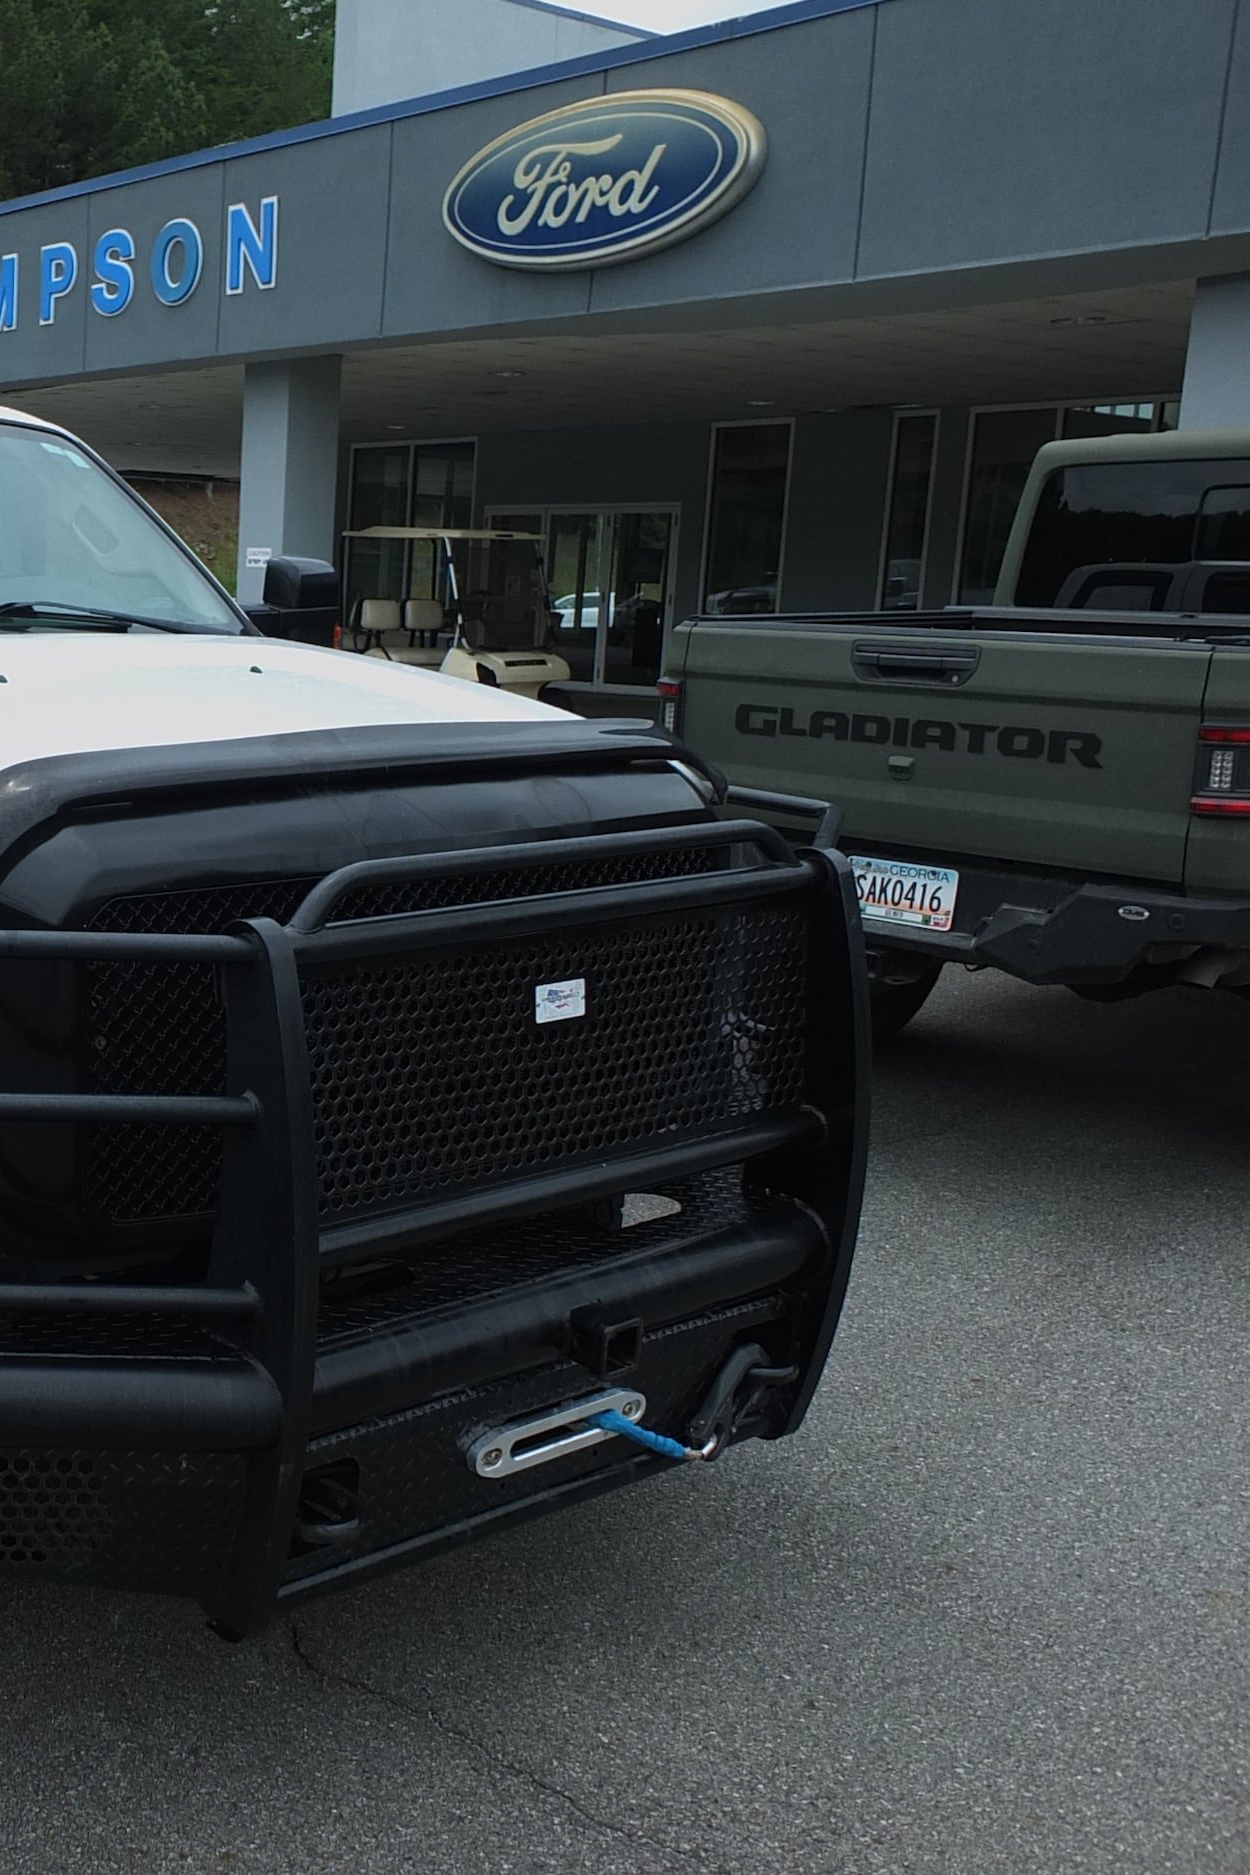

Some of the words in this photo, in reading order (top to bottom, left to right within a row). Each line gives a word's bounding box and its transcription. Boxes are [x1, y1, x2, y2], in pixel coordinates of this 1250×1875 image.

[497, 133, 667, 236] Ford
[735, 703, 1103, 769] GLADIATOR
[856, 873, 943, 913] SAK0416
[889, 864, 950, 884] GEORGIA
